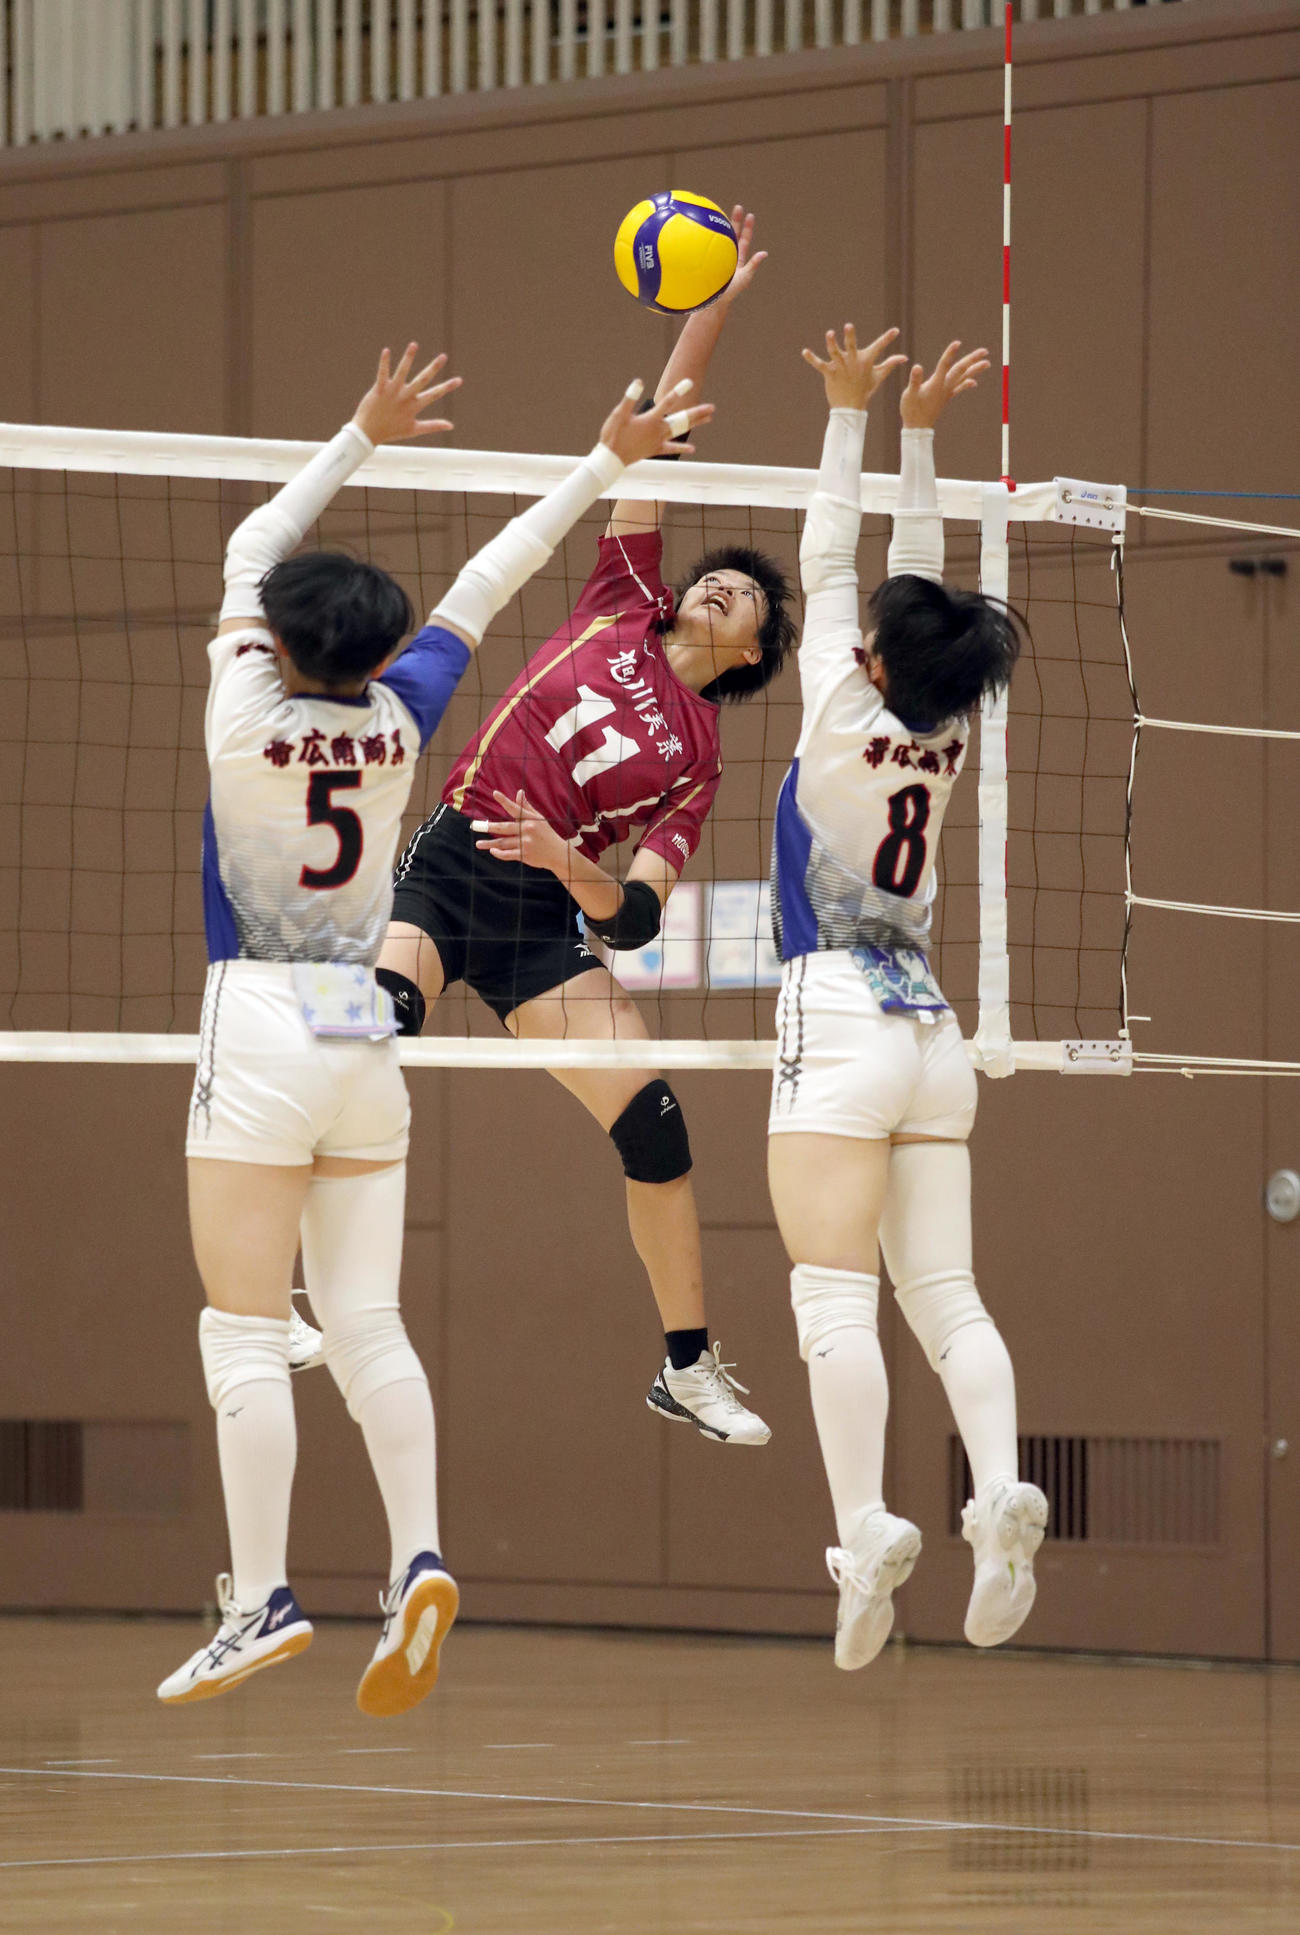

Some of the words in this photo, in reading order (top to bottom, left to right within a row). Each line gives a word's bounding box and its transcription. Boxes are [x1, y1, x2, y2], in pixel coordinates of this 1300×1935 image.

[645, 245, 654, 269] FIVB
[544, 684, 641, 787] 11
[606, 649, 683, 762] 旭川実業
[299, 770, 364, 890] 5
[872, 783, 931, 898] 8
